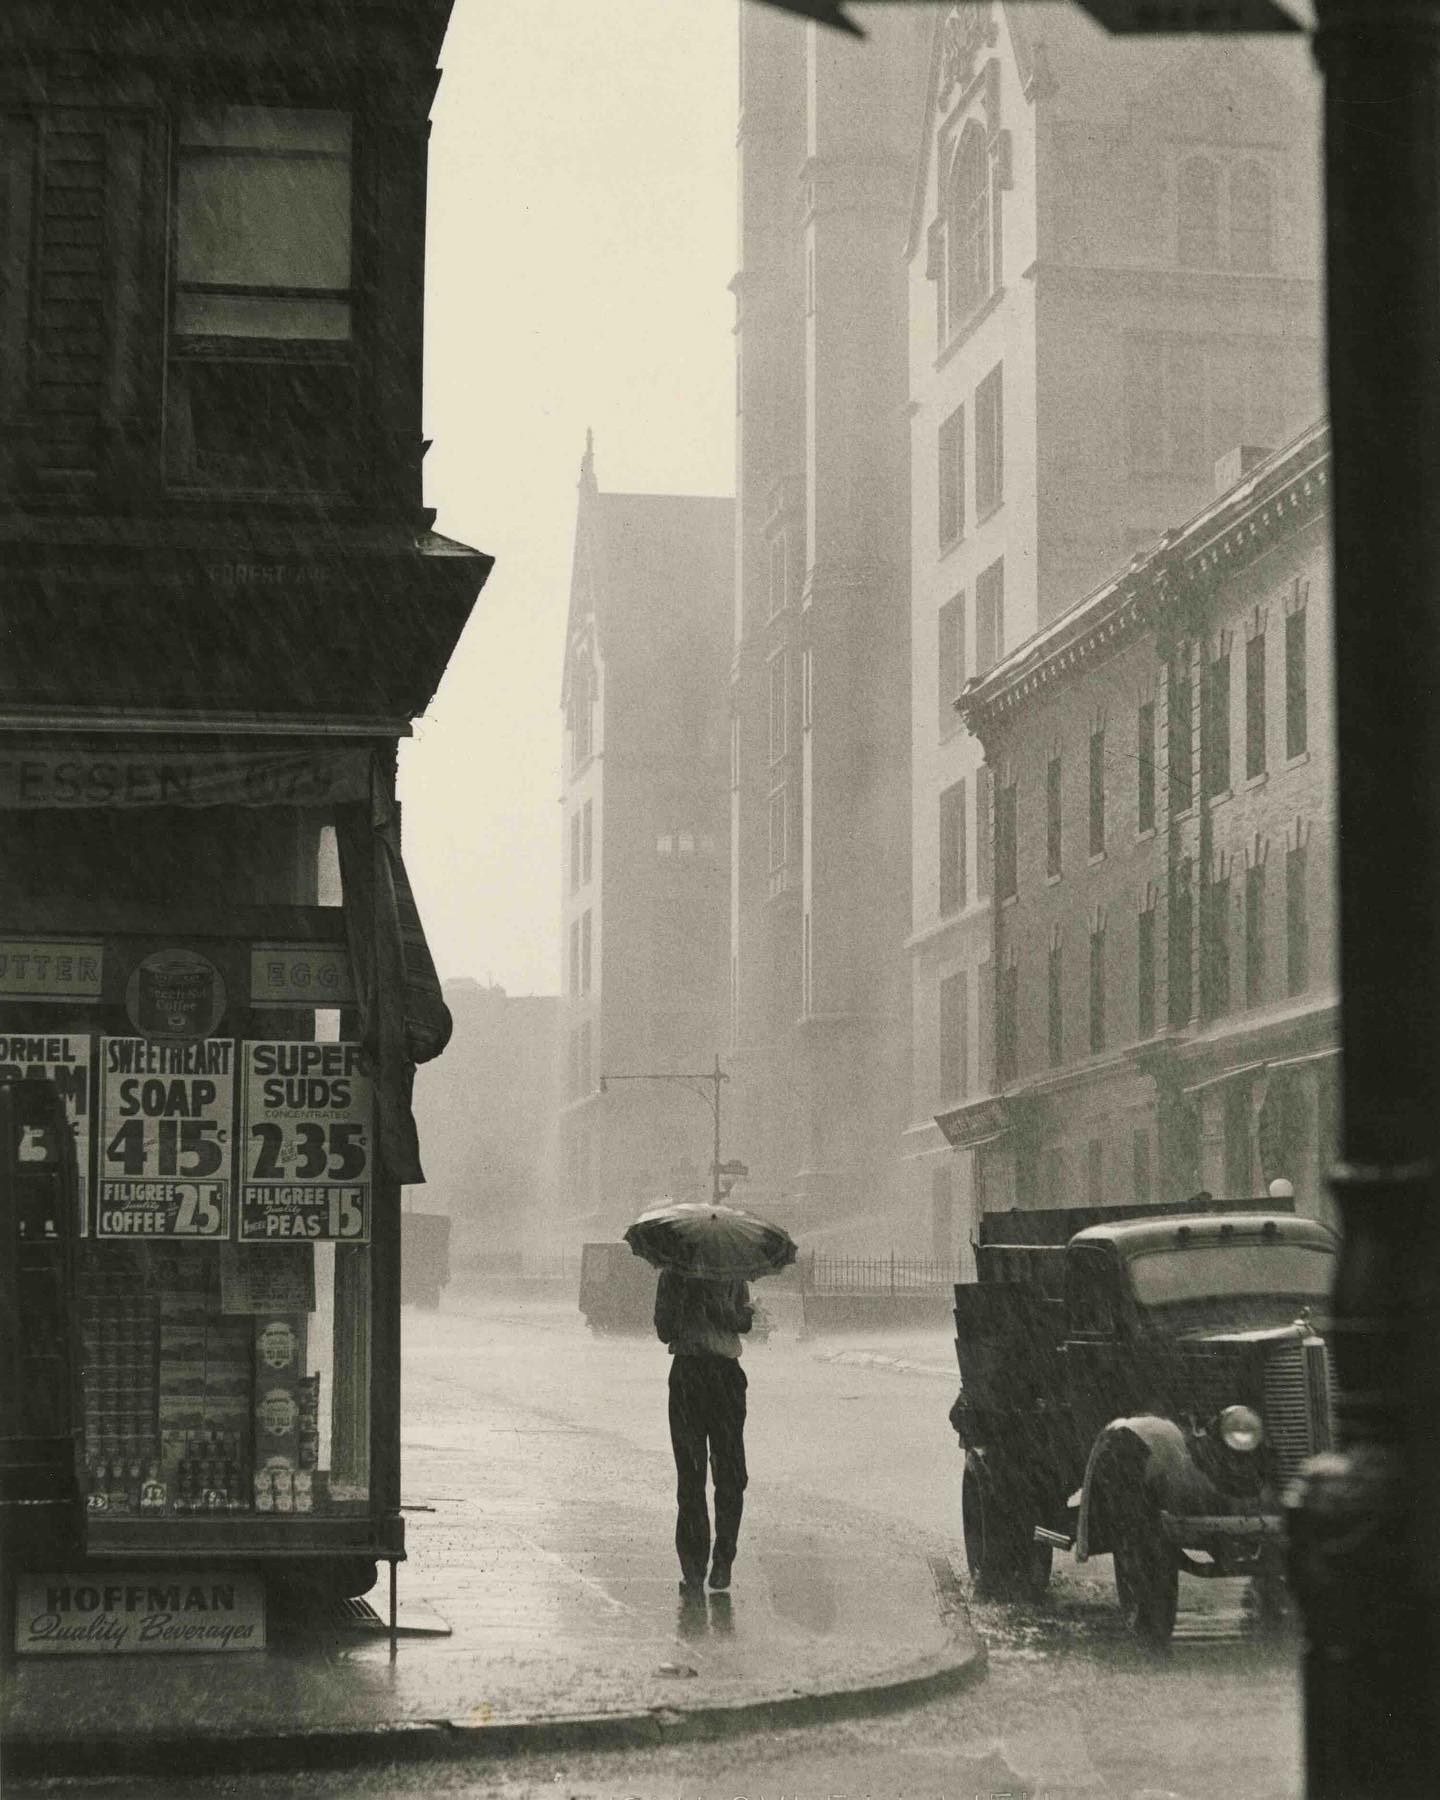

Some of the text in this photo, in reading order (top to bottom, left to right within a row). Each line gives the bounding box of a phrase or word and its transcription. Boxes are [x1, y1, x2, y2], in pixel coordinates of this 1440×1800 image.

[0, 761, 192, 802] ESSEN
[108, 1039, 232, 1075] SWEETHEART
[253, 1045, 370, 1077] SUPER
[119, 1078, 216, 1117] SOAP
[263, 1078, 352, 1109] SUDS
[264, 1109, 351, 1120] CONCENTRATED
[106, 1119, 147, 1176] 4
[251, 1122, 285, 1179] 2
[103, 1183, 174, 1202] FILIGREE
[245, 1187, 325, 1205] FILIGREE
[102, 1211, 166, 1233] COFFEE
[266, 1214, 321, 1237] PEAS
[46, 1585, 235, 1613] HOFFMAN
[28, 1612, 256, 1648] Quality Beverages
